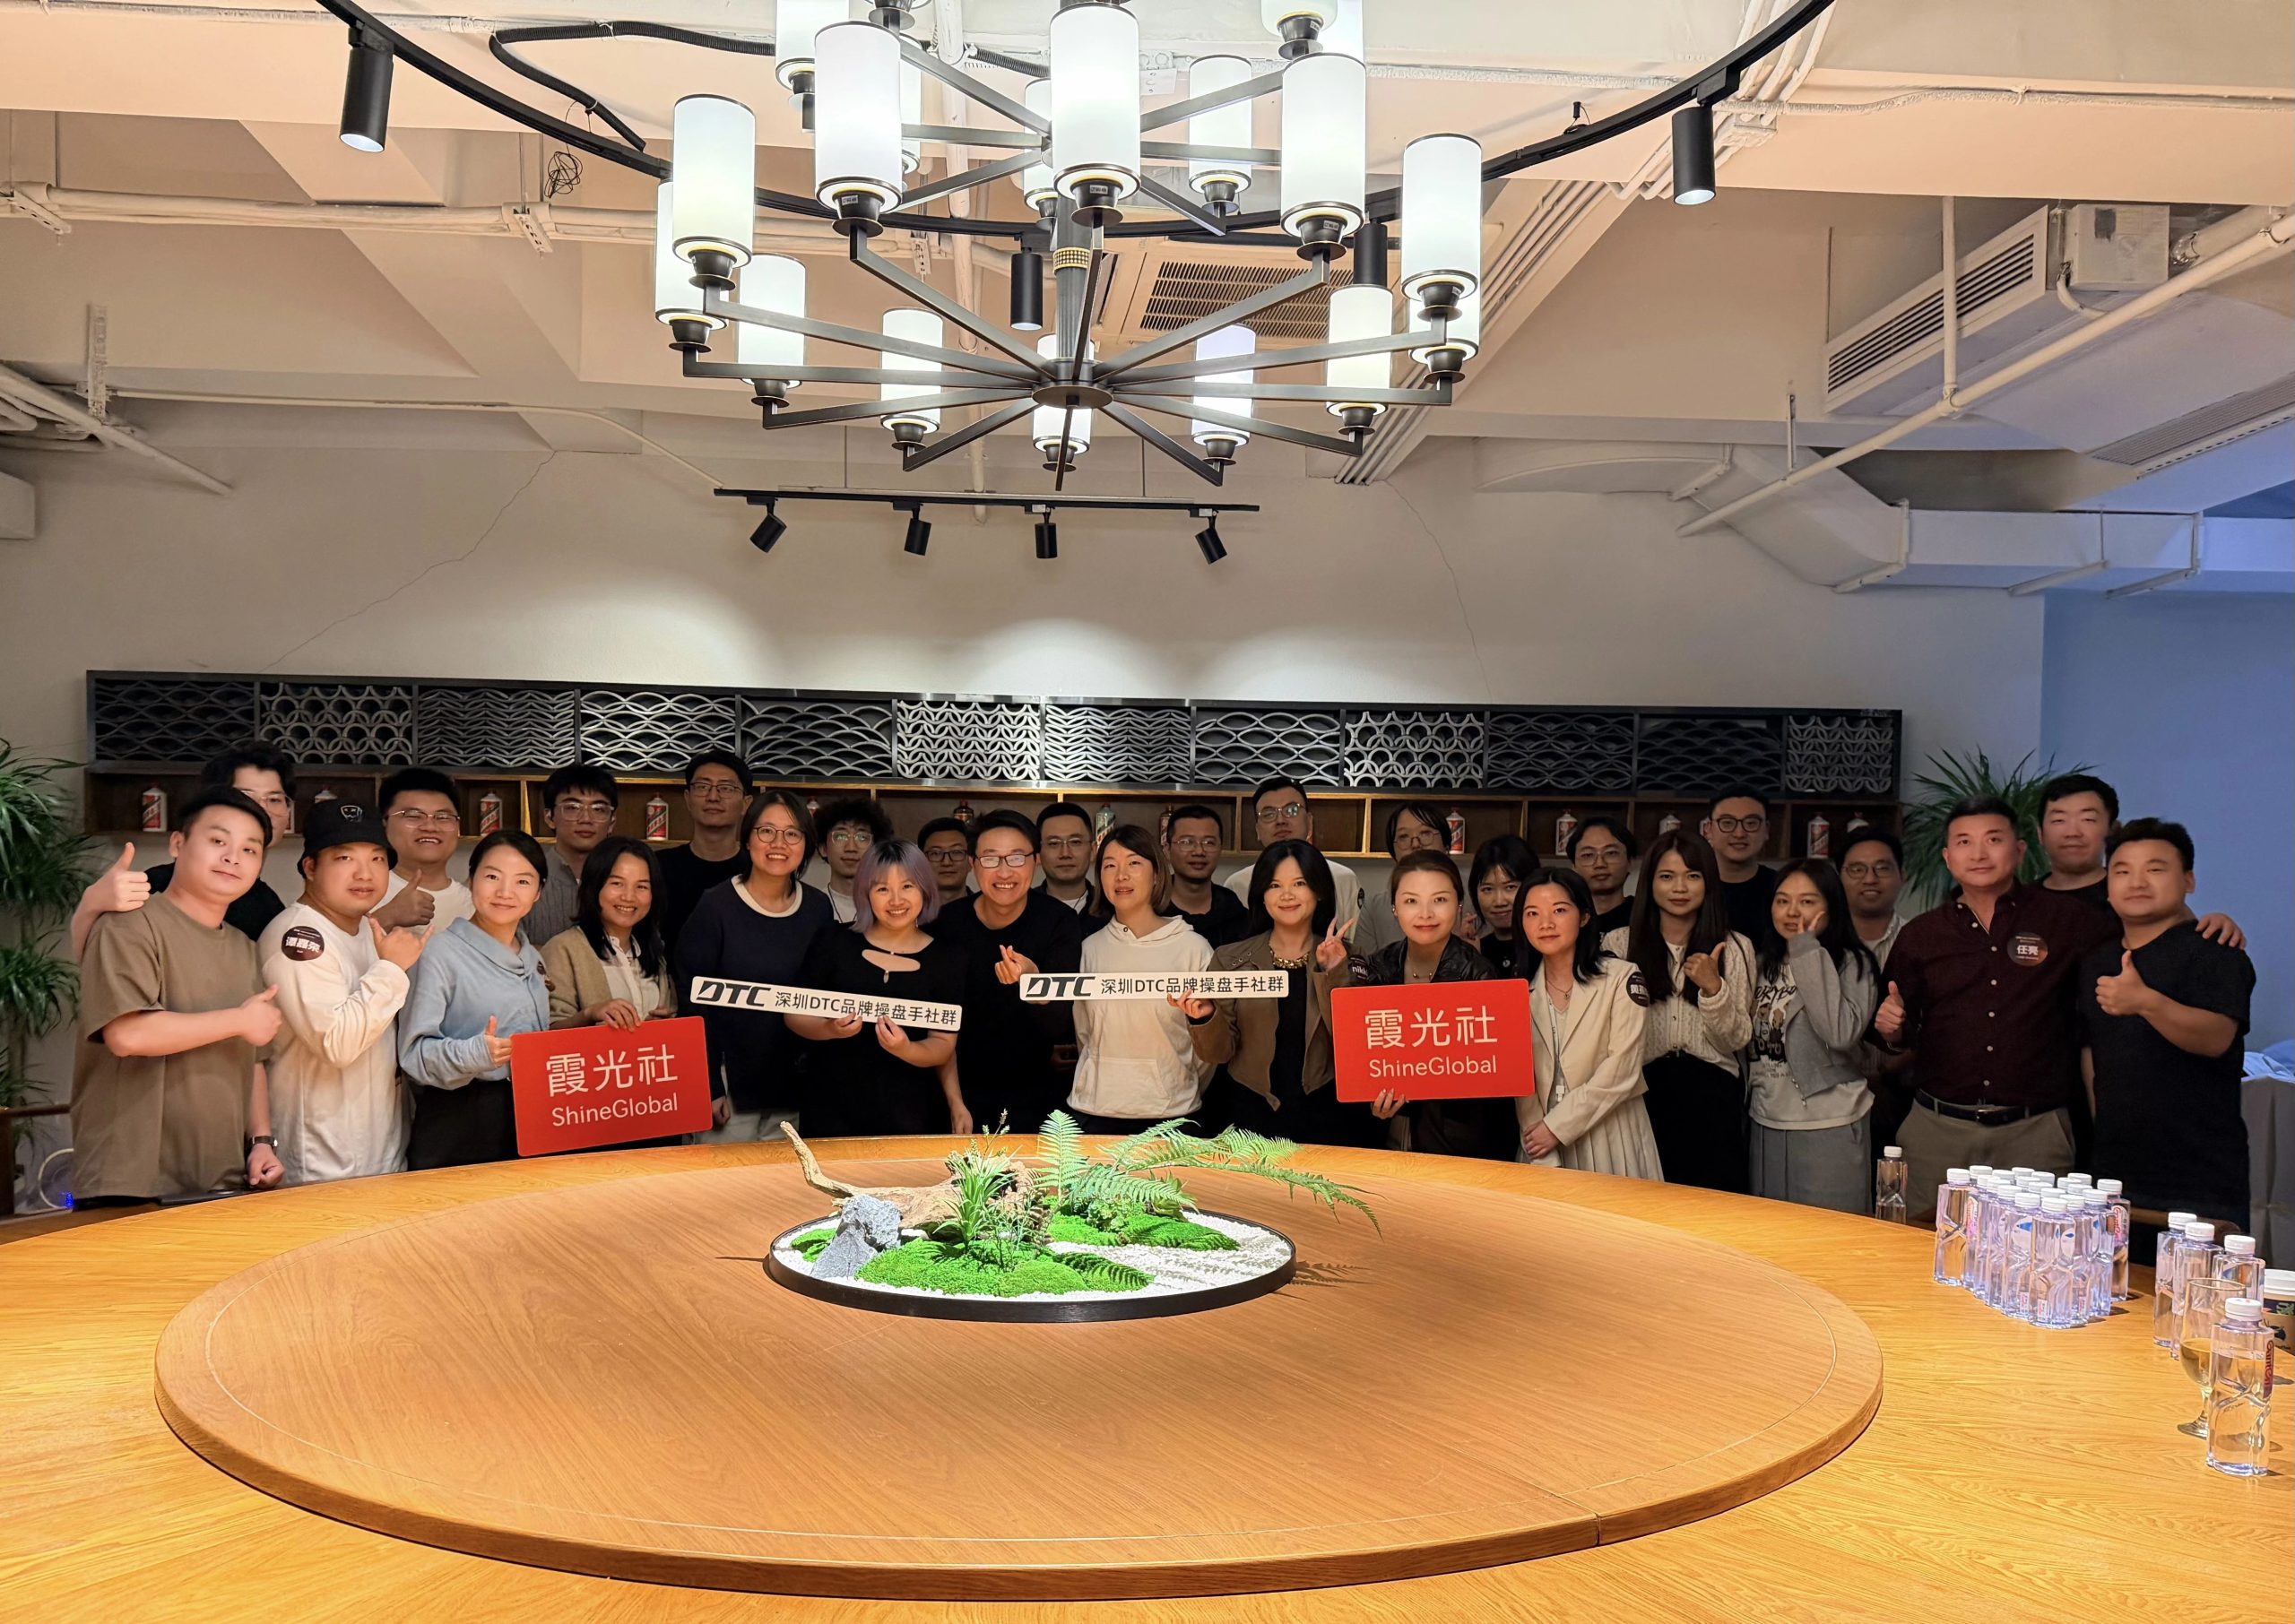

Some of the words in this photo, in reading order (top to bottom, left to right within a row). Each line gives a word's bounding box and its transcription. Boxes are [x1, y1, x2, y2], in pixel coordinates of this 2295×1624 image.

[2017, 945, 2039, 955] 任亮
[697, 980, 772, 1007] DTC
[775, 990, 957, 1025] 深圳DTC品牌操盘手社群
[1026, 976, 1096, 998] DTC
[1101, 975, 1285, 995] 深圳DTC品牌操盘手社群
[1364, 1005, 1498, 1050] 霞光社
[546, 1044, 679, 1097] 霞光社
[1369, 1055, 1497, 1078] ShineGlobal
[551, 1093, 678, 1127] ShineGlobal
